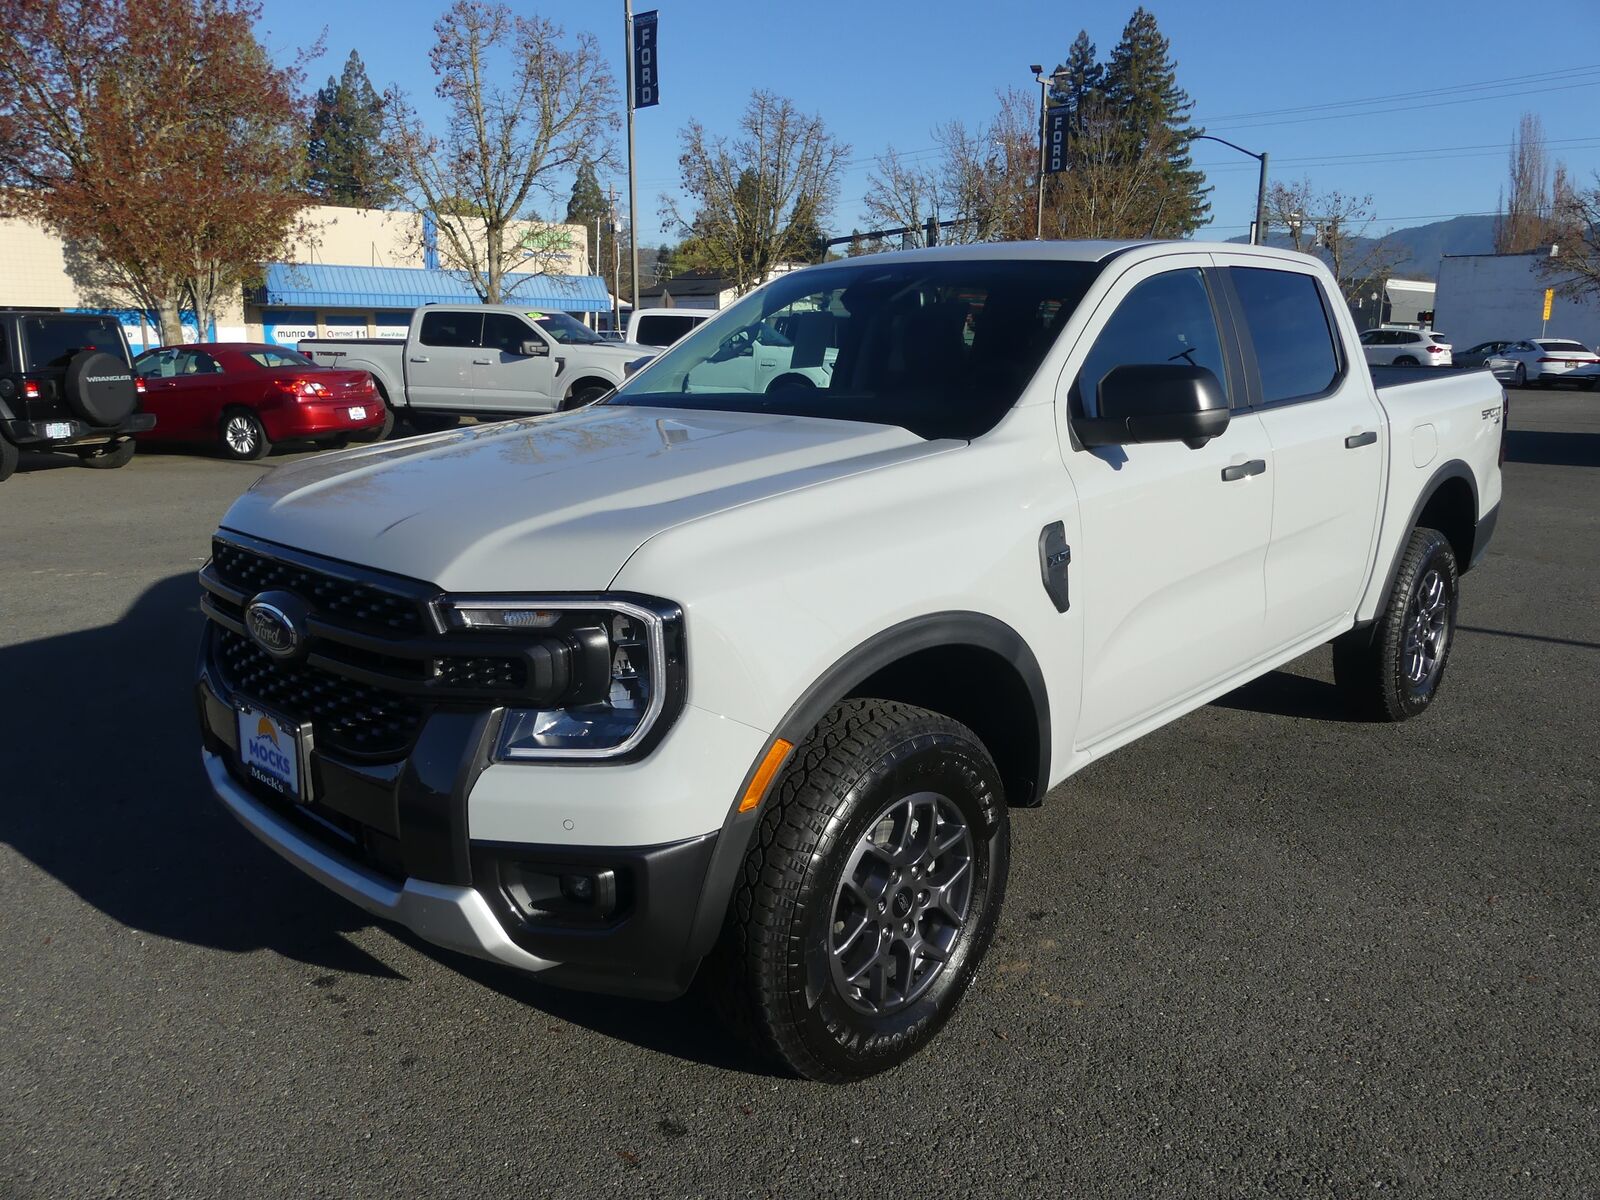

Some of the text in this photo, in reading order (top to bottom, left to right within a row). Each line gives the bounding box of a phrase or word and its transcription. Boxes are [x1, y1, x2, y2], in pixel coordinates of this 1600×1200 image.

[641, 28, 651, 103] FORD
[1052, 117, 1062, 171] FORD
[277, 330, 306, 338] munro
[86, 375, 131, 383] WRANGLER
[249, 739, 290, 775] MOCKS
[251, 767, 285, 794] Mock's
